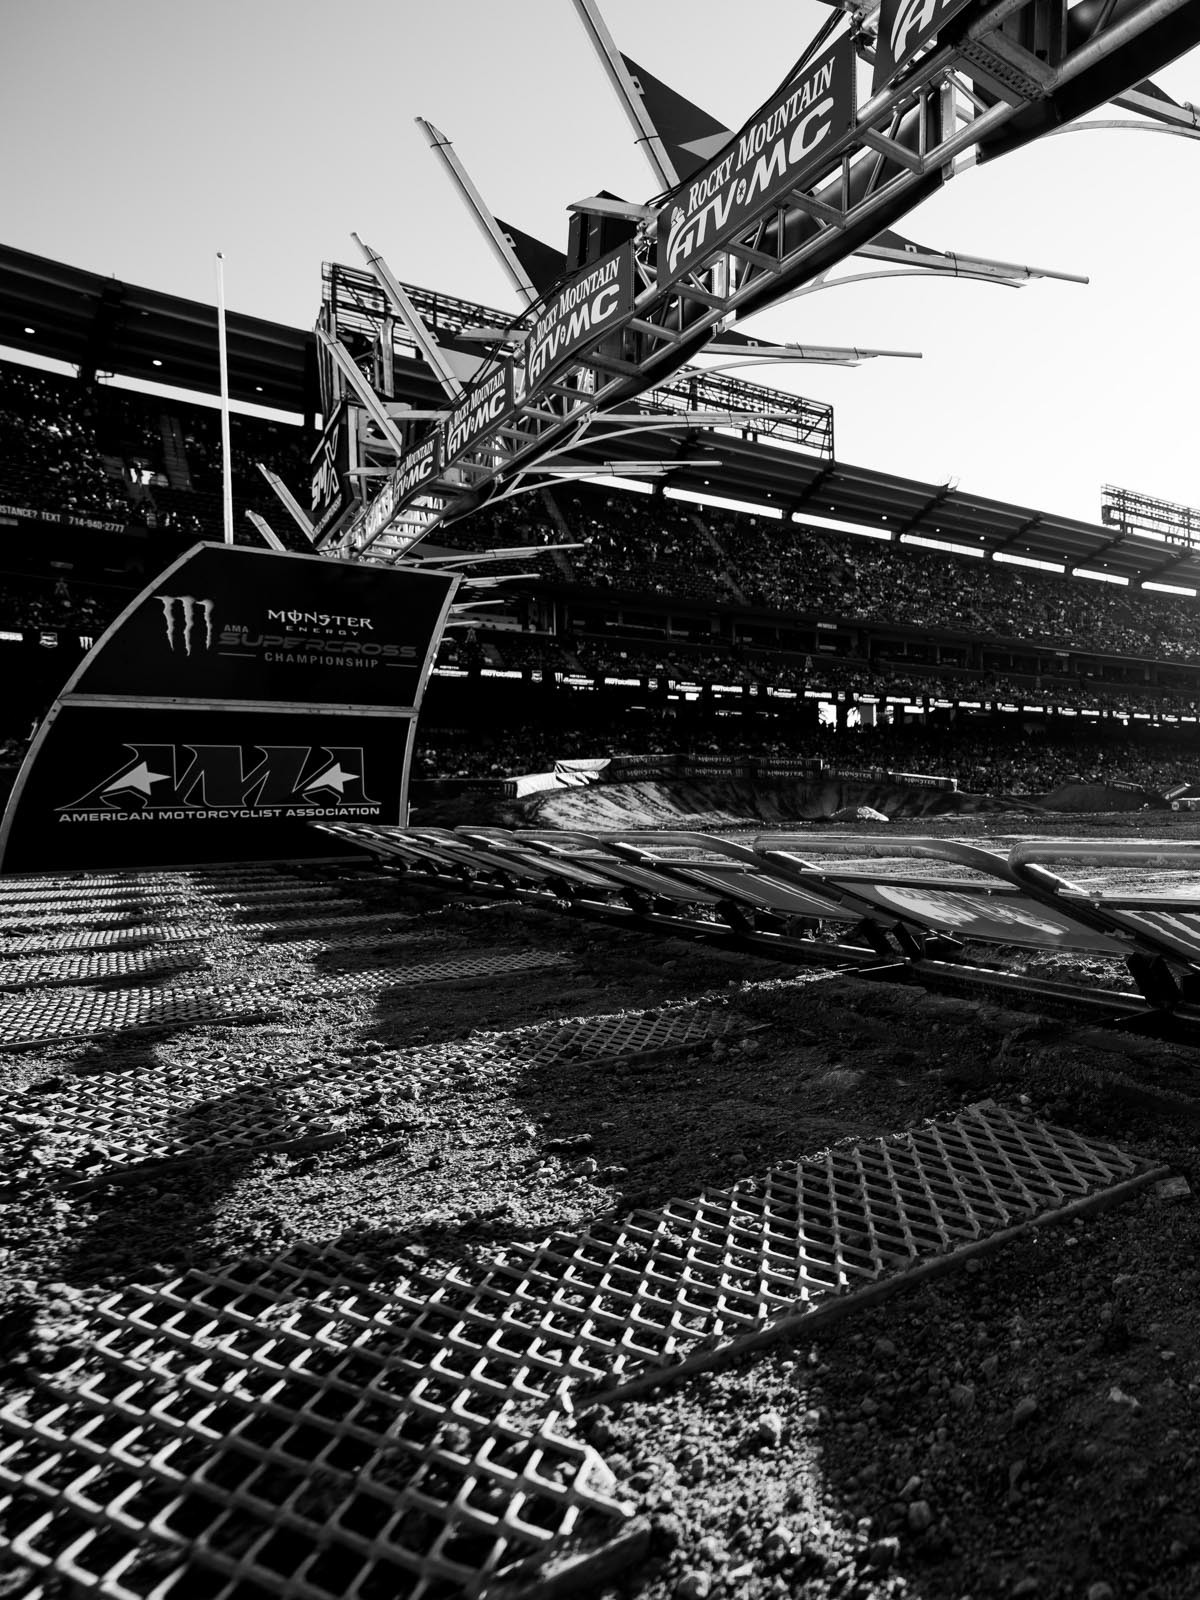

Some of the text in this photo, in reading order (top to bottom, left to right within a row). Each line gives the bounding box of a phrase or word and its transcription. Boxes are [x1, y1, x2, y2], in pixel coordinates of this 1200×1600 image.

[687, 56, 836, 217] ROCKY MOUNTAIN
[536, 256, 621, 345] ROCKY MOUNTAIN
[454, 367, 506, 425] ROCKY MOUNTAIN
[41, 511, 61, 522] TEXT
[223, 624, 249, 633] AMA
[266, 608, 374, 630] MONSTER
[285, 625, 360, 636] ENERGY
[218, 632, 417, 658] SUPERCROSS
[264, 652, 379, 668] CHAMPIONSHIP
[53, 743, 383, 810] AMA
[58, 806, 380, 822] AMERICAN MOTORCYCLIST ASSOCIATION
